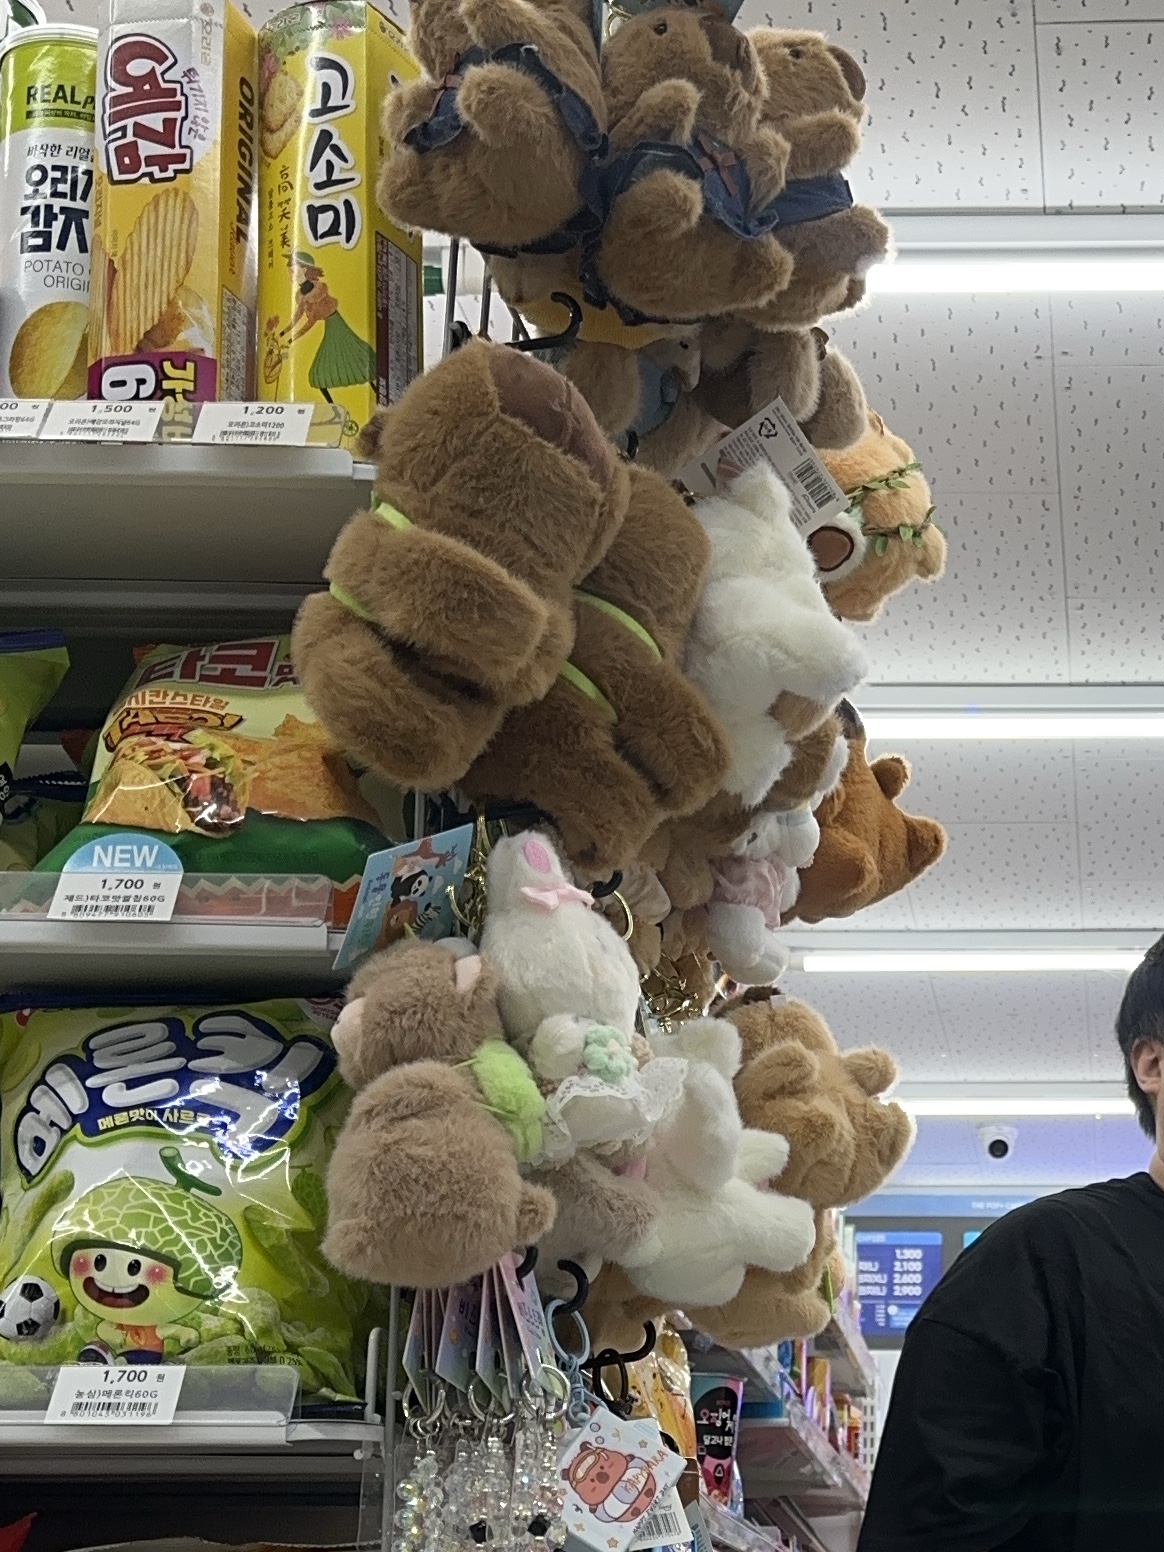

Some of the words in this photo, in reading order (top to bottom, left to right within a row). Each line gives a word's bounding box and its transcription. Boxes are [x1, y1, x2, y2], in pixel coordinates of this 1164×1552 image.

[105, 35, 192, 182] 예감
[308, 56, 358, 244] 고소미
[238, 76, 255, 244] ORIGINAL
[24, 259, 84, 277] POTATO
[91, 404, 133, 414] 1,500
[243, 405, 284, 415] 1,200
[92, 845, 159, 868] NEW
[101, 878, 144, 891] 1,700
[102, 1369, 147, 1384] 1,700
